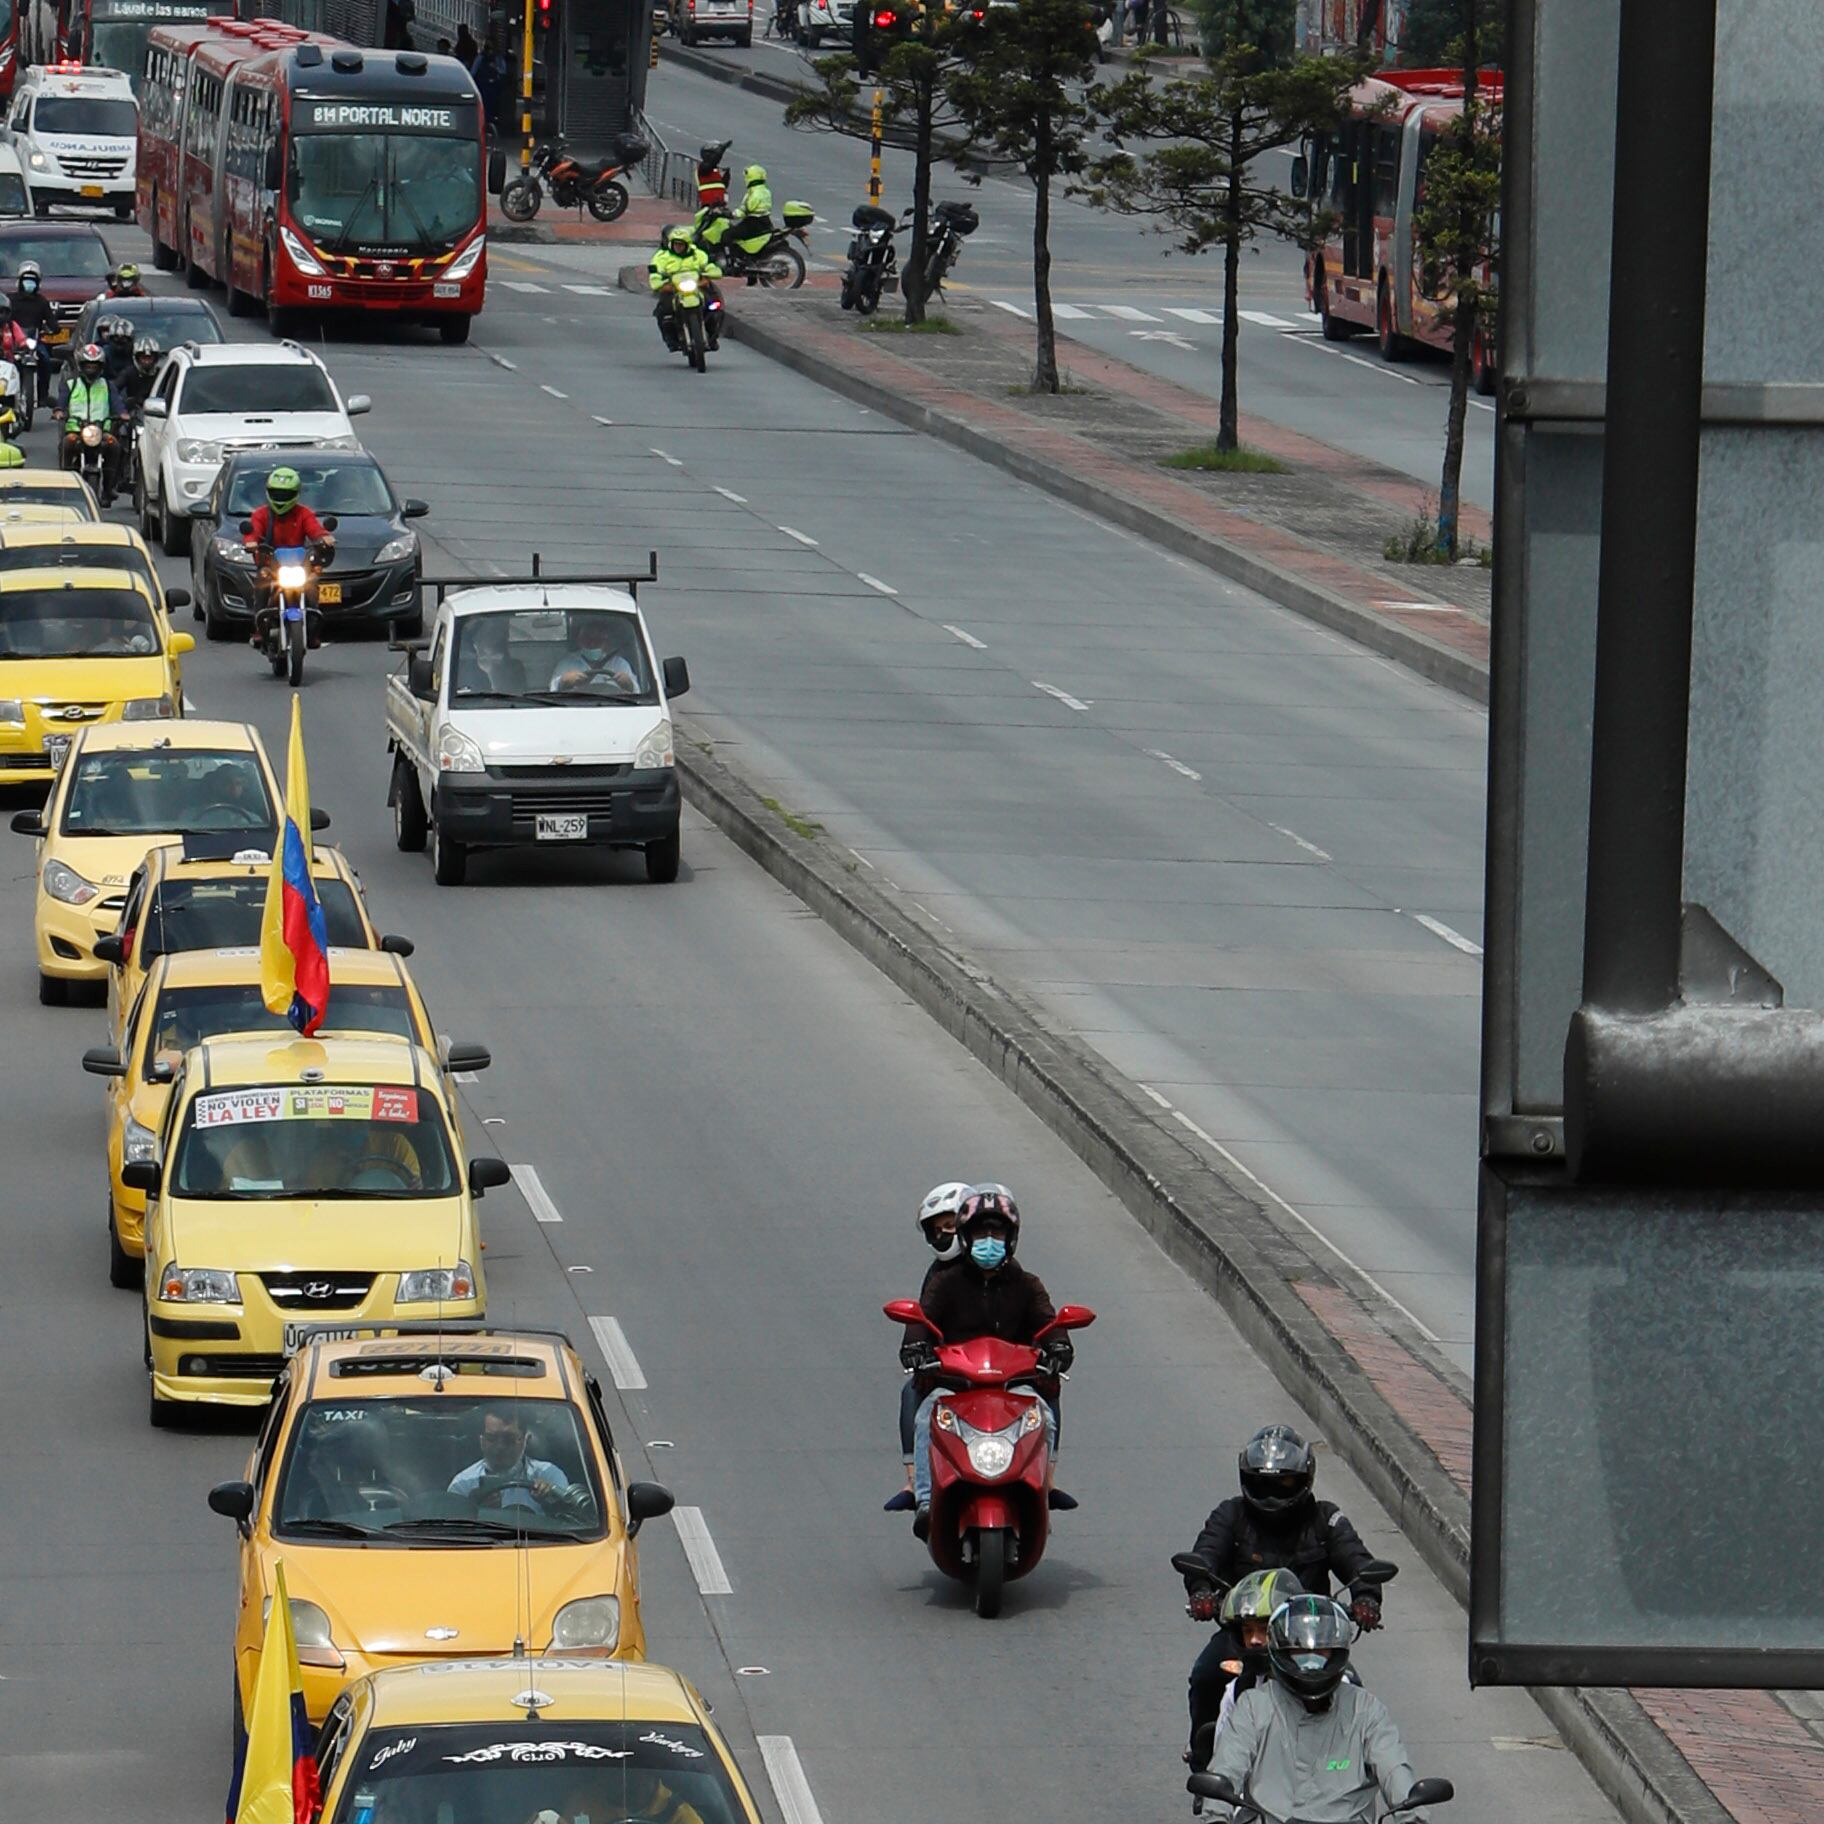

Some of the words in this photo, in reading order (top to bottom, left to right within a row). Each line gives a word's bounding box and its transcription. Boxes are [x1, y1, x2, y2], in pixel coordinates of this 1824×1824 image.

[155, 3, 172, 16] las
[339, 106, 399, 125] PORTAL
[401, 108, 451, 126] NORTE
[289, 1088, 370, 1097] PLATAFORMAS
[207, 1101, 226, 1111] NO
[231, 1096, 280, 1108] VIOLEN
[328, 1097, 343, 1109] NO
[207, 1109, 233, 1123] LA
[242, 1105, 279, 1119] LEY
[324, 1410, 365, 1421] TAXI
